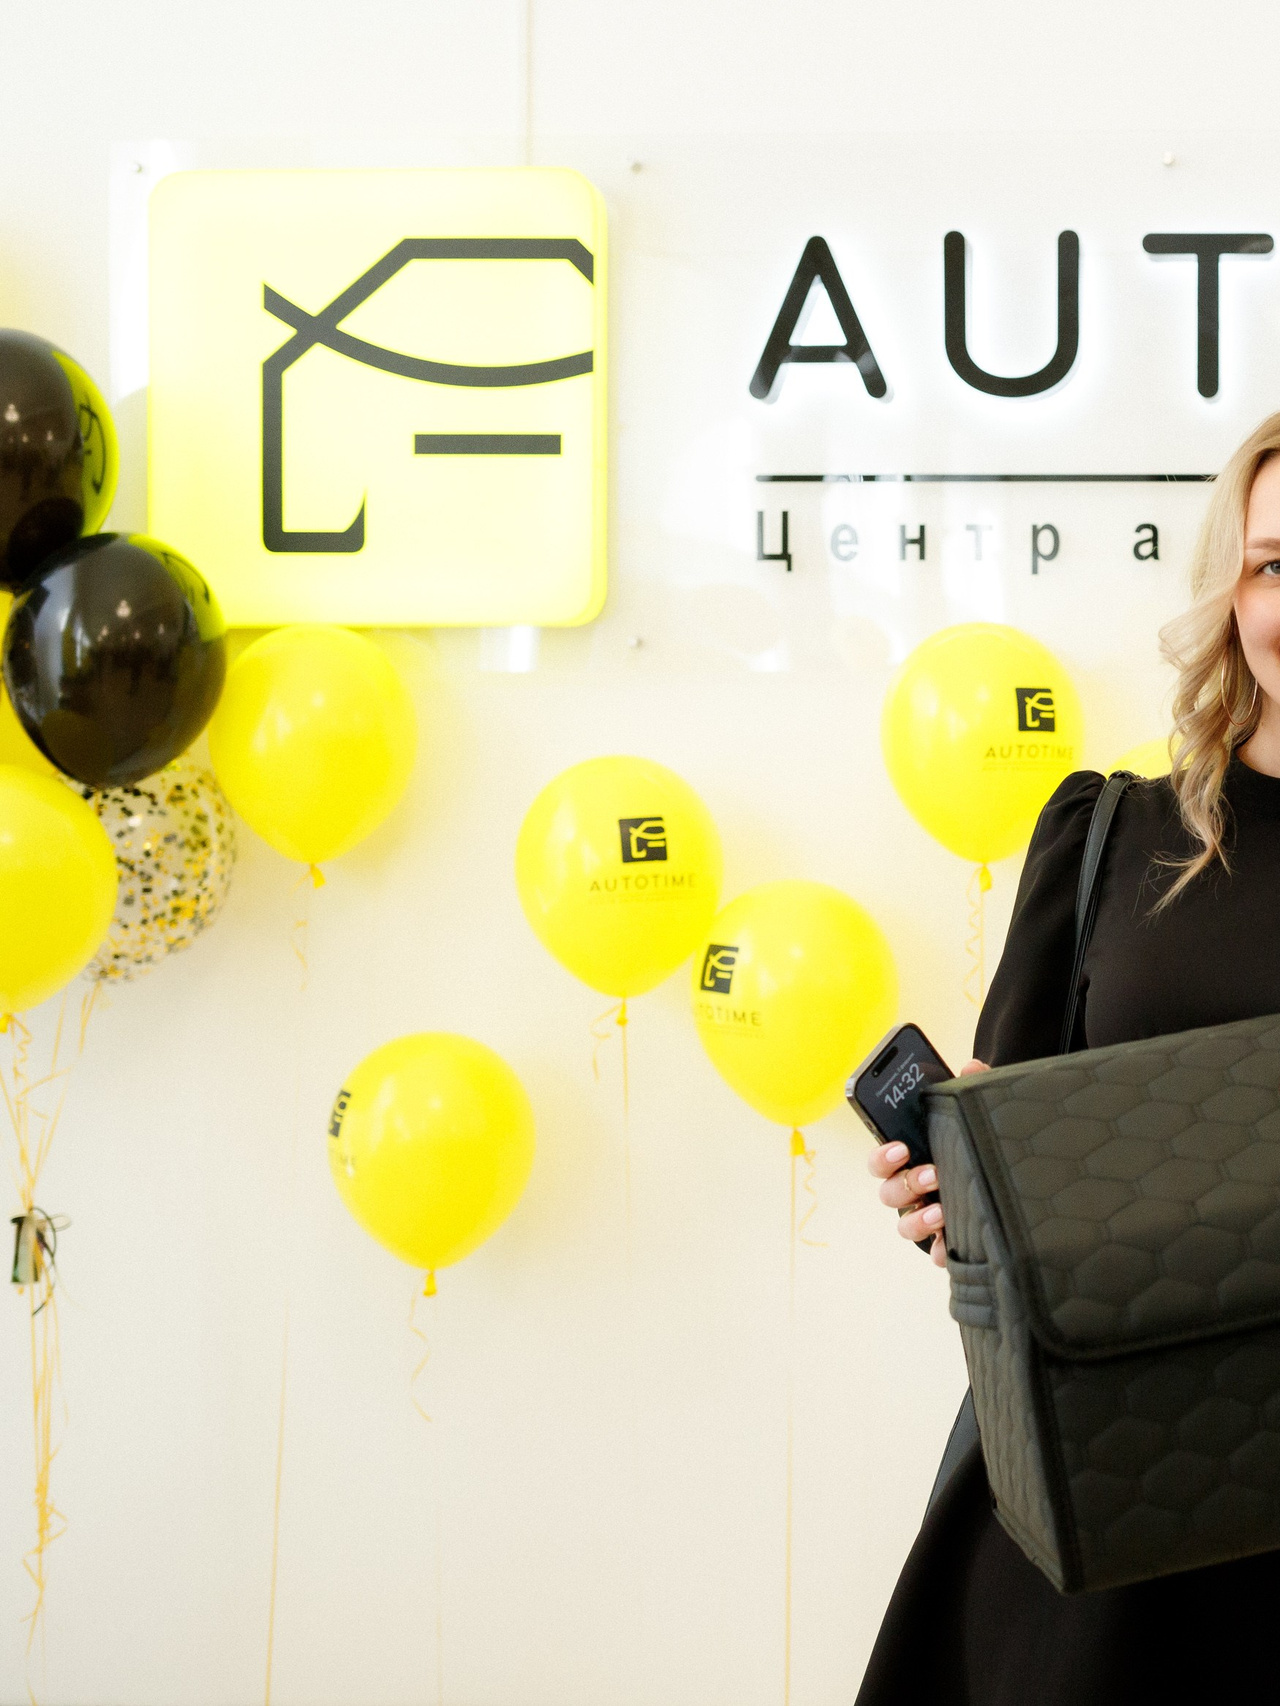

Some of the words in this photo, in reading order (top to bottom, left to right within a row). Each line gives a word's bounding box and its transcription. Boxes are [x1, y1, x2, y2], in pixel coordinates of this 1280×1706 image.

[756, 510, 1060, 575] Центр
[985, 744, 1074, 760] AUTOTIME
[589, 874, 696, 892] AUTOTIME
[884, 1062, 925, 1109] 14:32
